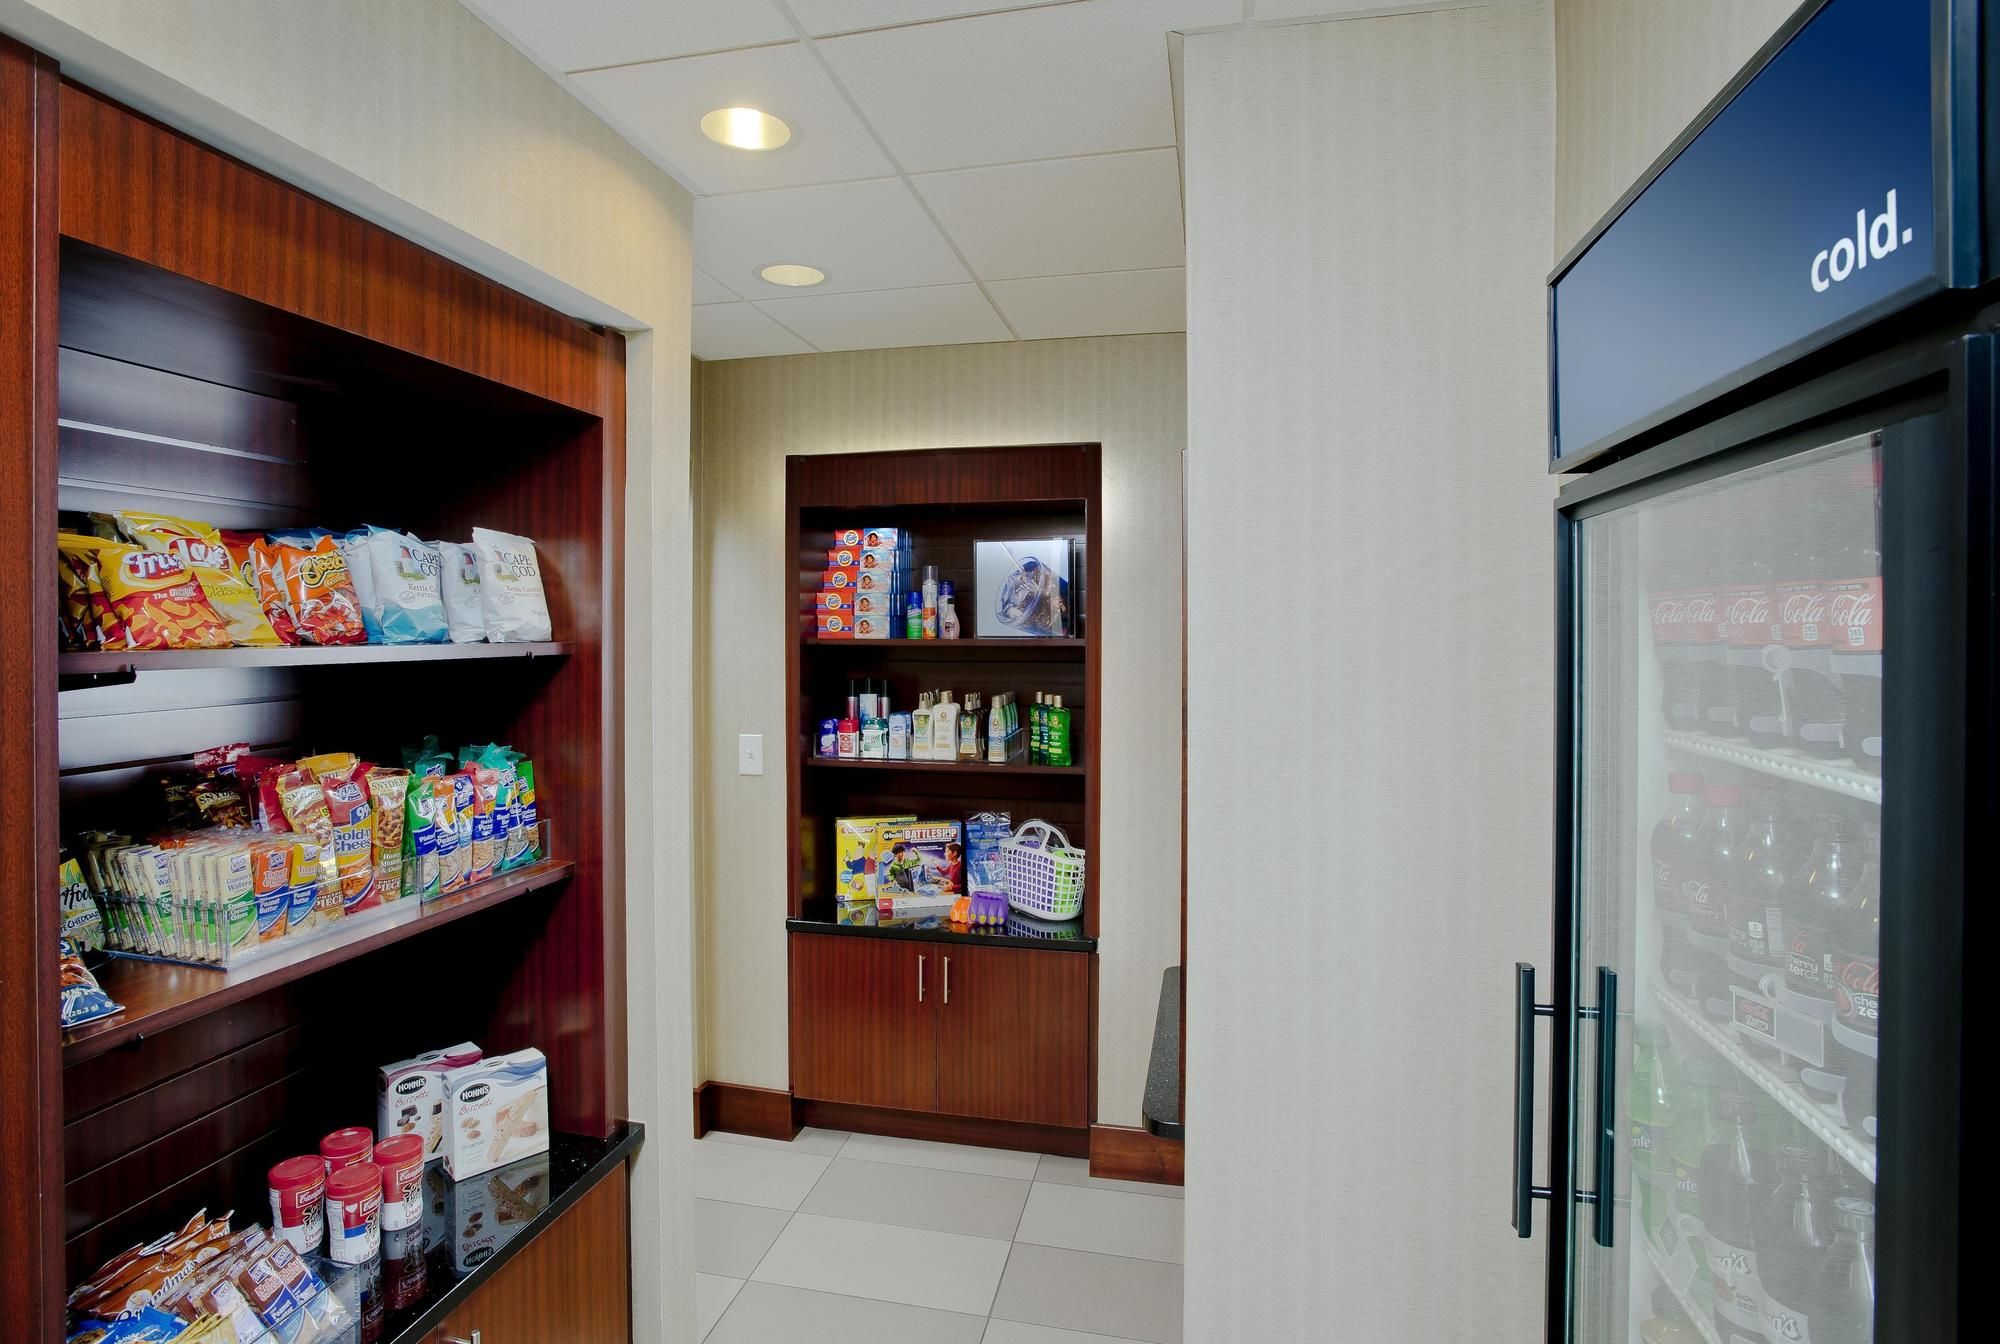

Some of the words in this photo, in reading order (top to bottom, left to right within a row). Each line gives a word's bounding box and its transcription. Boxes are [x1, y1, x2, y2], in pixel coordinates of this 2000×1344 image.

[1810, 188, 1913, 293] cold.
[844, 532, 858, 544] Tide
[503, 552, 533, 566] CAPE
[838, 553, 851, 564] Tide
[512, 565, 536, 577] COD
[832, 574, 846, 585] Tide
[153, 591, 169, 601] The
[827, 596, 841, 607] Tide
[1686, 598, 1715, 624] Cola
[1729, 597, 1771, 625] Cola
[1783, 593, 1826, 624] Cola
[1831, 592, 1877, 627] Cola
[828, 618, 841, 629] Tide
[904, 827, 958, 841] BATTLESHIP
[397, 1077, 426, 1094] NONNI'S
[460, 1084, 490, 1102] NONNI'S
[394, 1089, 430, 1109] Biscotti
[459, 1097, 495, 1117] Biscotti
[115, 1258, 198, 1322] Grndma's
